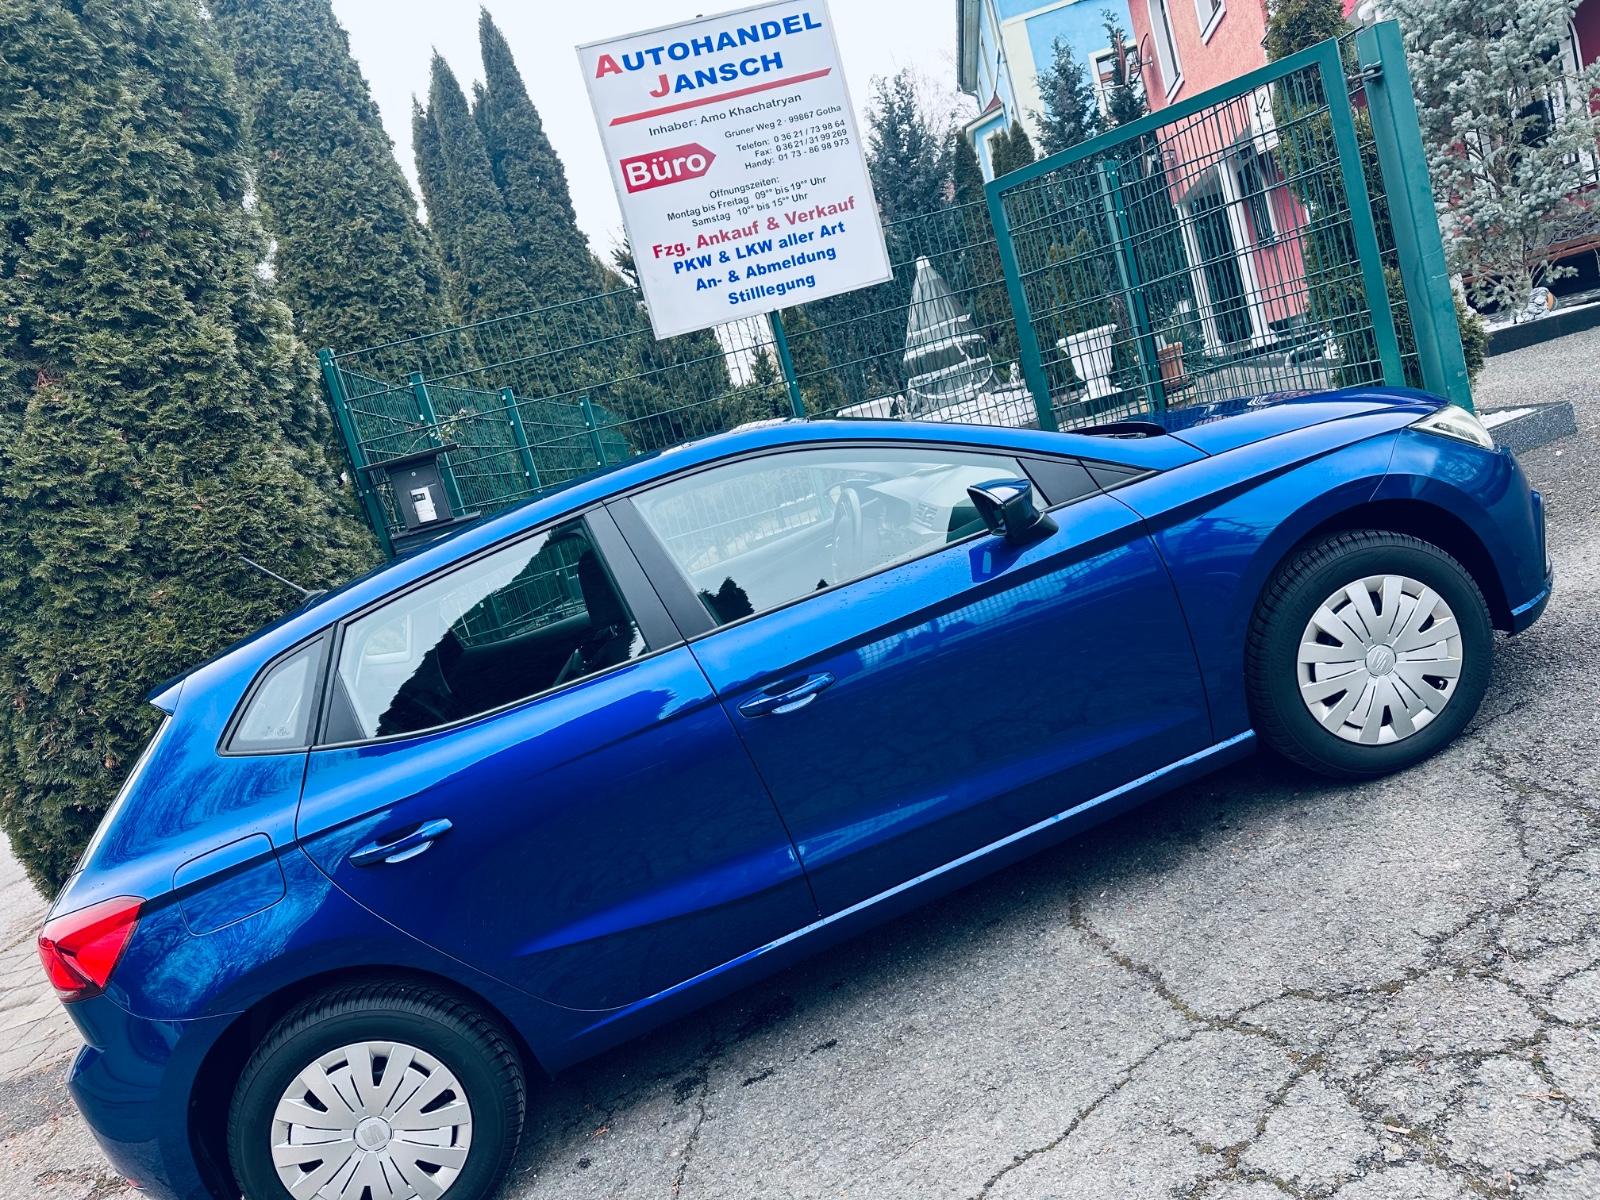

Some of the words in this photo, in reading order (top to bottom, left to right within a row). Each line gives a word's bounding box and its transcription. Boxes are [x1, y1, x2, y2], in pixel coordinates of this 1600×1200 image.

[595, 12, 822, 78] AUTOHANDEL
[650, 51, 783, 97] JANSCH
[648, 119, 697, 136] Inhaber:
[728, 94, 802, 117] Khachatryan
[755, 122, 775, 131] Weg
[776, 118, 782, 126] 2
[788, 110, 814, 123] 99867
[815, 105, 842, 116] Gotha
[735, 139, 770, 152] Telefon:
[773, 135, 780, 143] 0
[780, 132, 792, 141] 36
[792, 129, 803, 138] 21
[810, 125, 821, 134] 73
[821, 122, 833, 131] 98
[834, 119, 845, 128] 64
[744, 157, 774, 170] Handy:
[777, 152, 788, 161] 01
[790, 149, 802, 158] 73
[808, 144, 820, 154] 86
[820, 142, 832, 151] 98
[833, 137, 850, 148] 973
[754, 148, 773, 158] Fax:
[831, 128, 847, 138] 269
[625, 152, 706, 186] Büro
[666, 208, 701, 221] Montag
[701, 204, 716, 213] bis
[717, 196, 749, 209] Freitag
[774, 186, 790, 195] bis
[809, 176, 826, 186] Uhr
[691, 212, 731, 227] Samstag
[756, 202, 770, 211] bis
[791, 193, 808, 203] Uhr
[652, 242, 691, 259] Fzg.
[696, 220, 759, 249] Ankauf
[766, 216, 780, 231] &
[783, 195, 854, 225] Verkauf
[673, 254, 712, 274] PKW
[718, 250, 731, 263] &
[735, 238, 772, 259] LKW
[778, 231, 814, 249] aller
[820, 221, 845, 238] Art
[696, 277, 722, 291] An-
[728, 269, 740, 283] &
[746, 247, 836, 279] Abmeldung
[728, 274, 816, 305] Stilllegung
